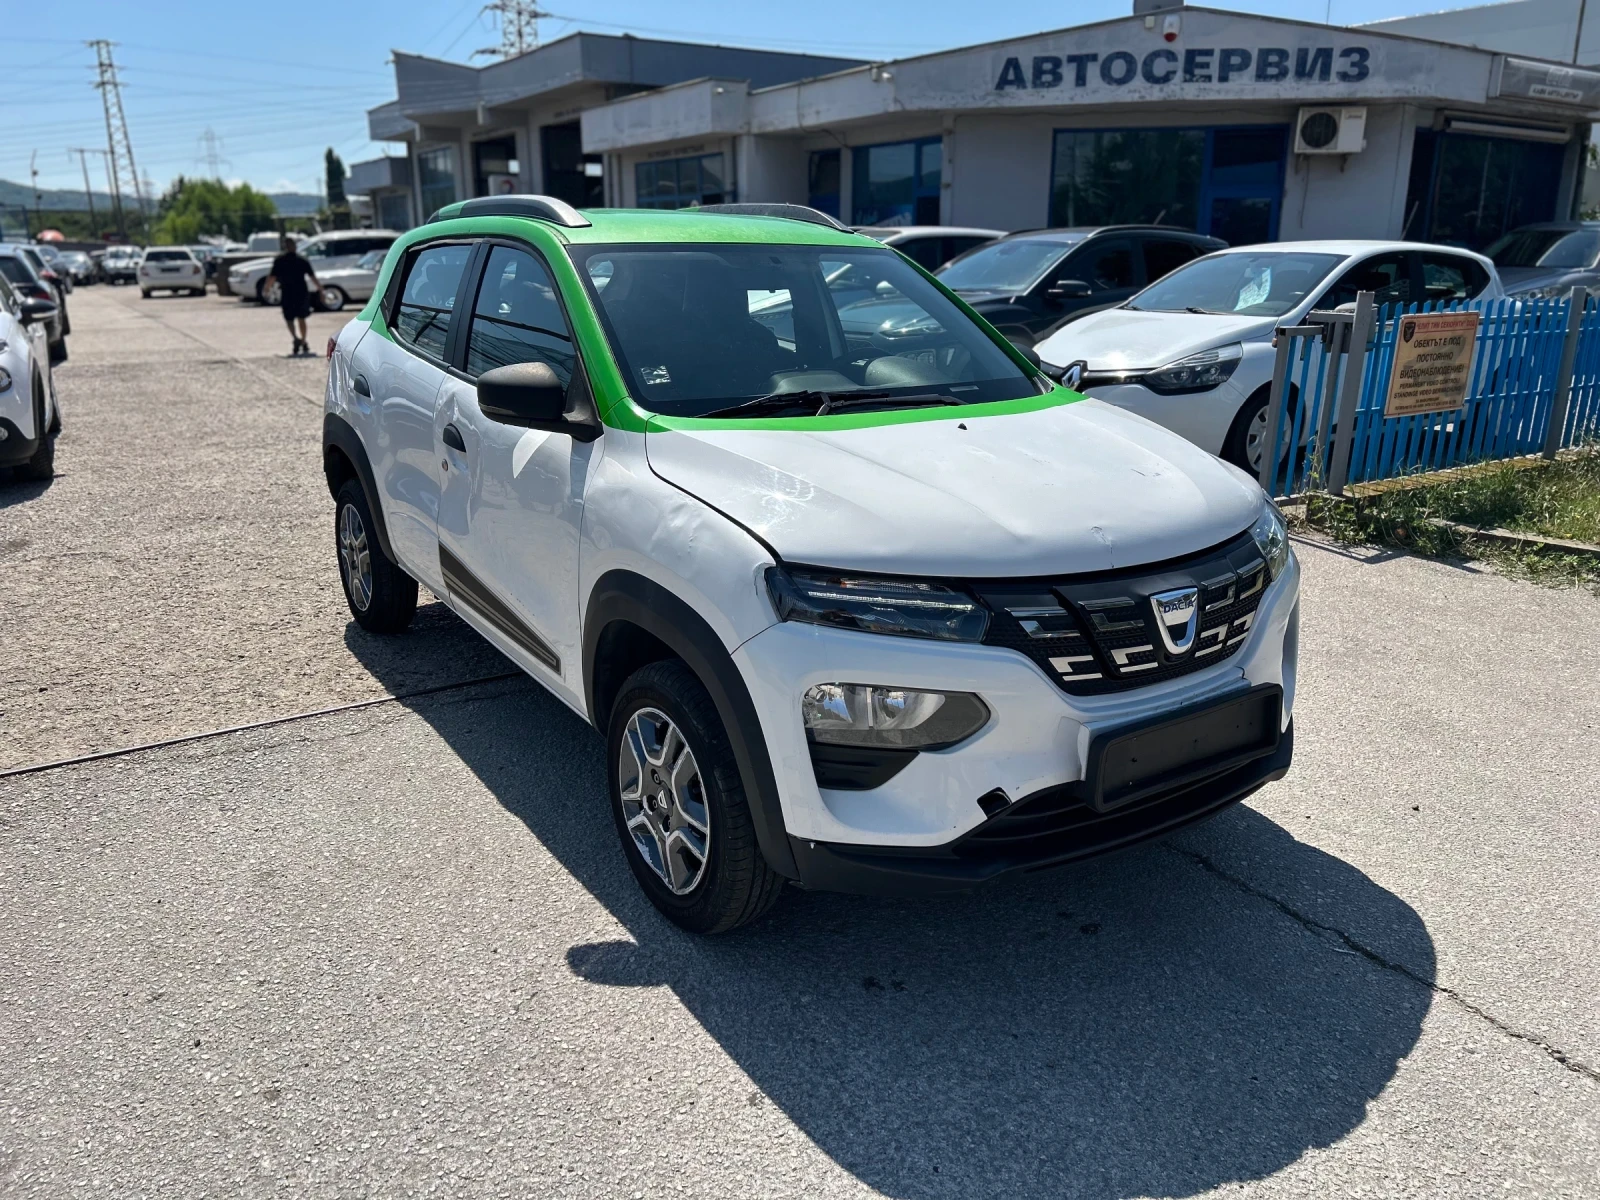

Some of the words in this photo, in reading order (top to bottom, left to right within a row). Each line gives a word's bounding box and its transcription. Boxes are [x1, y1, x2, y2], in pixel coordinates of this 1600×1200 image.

[995, 46, 1370, 90] АВТОСЕРВИЗ
[1413, 338, 1443, 349] ОБЕКТЪТ
[1447, 336, 1462, 346] ПОД
[1416, 352, 1454, 362] ПОСТОЯННО
[1163, 600, 1194, 613] DACIA
